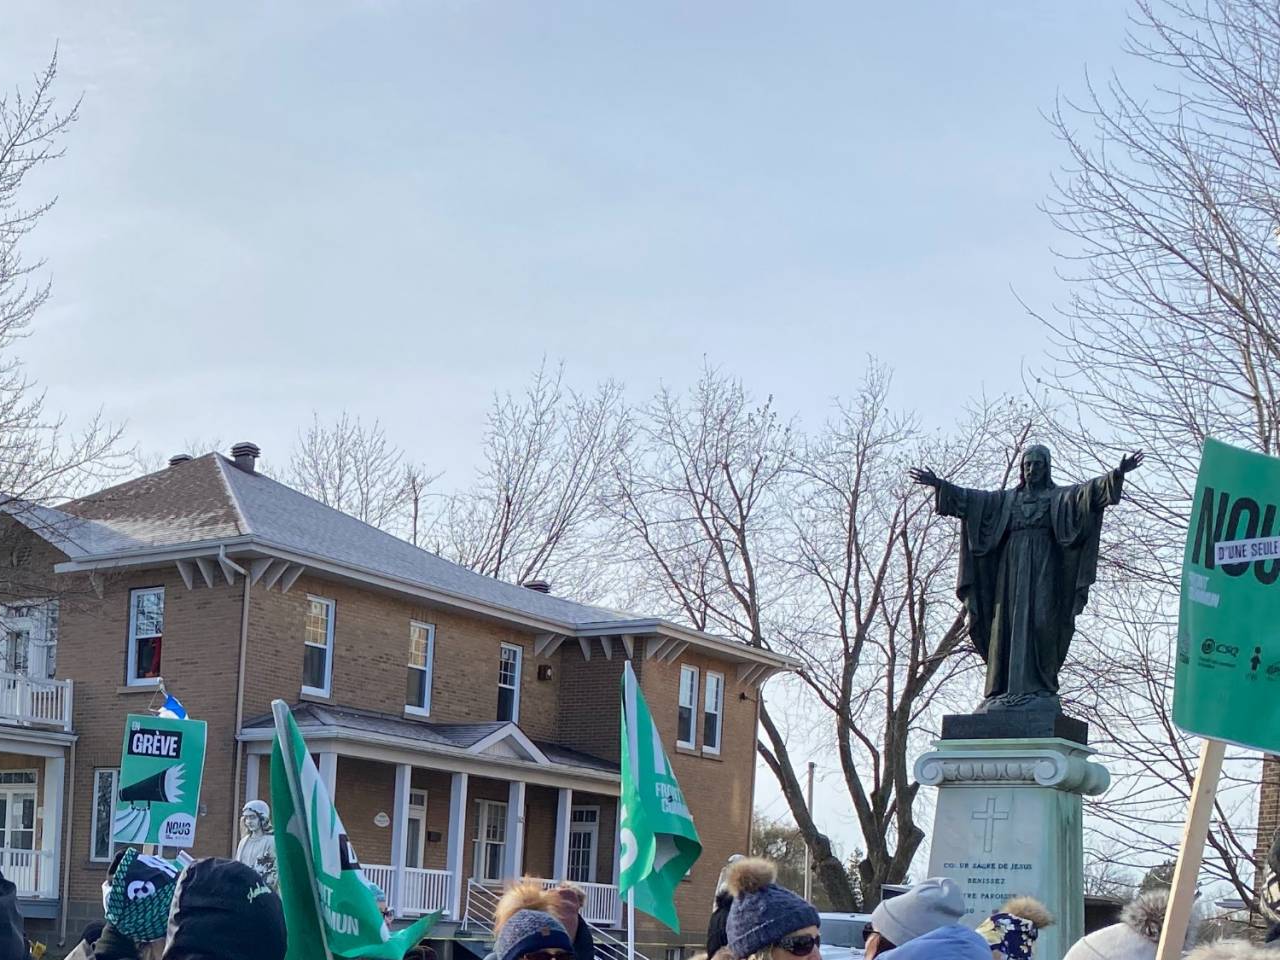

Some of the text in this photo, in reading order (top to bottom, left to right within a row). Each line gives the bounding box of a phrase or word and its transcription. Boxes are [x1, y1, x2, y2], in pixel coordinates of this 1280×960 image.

[1192, 487, 1280, 585] NOU
[132, 730, 179, 757] GRÈVE
[165, 820, 192, 836] NOUS
